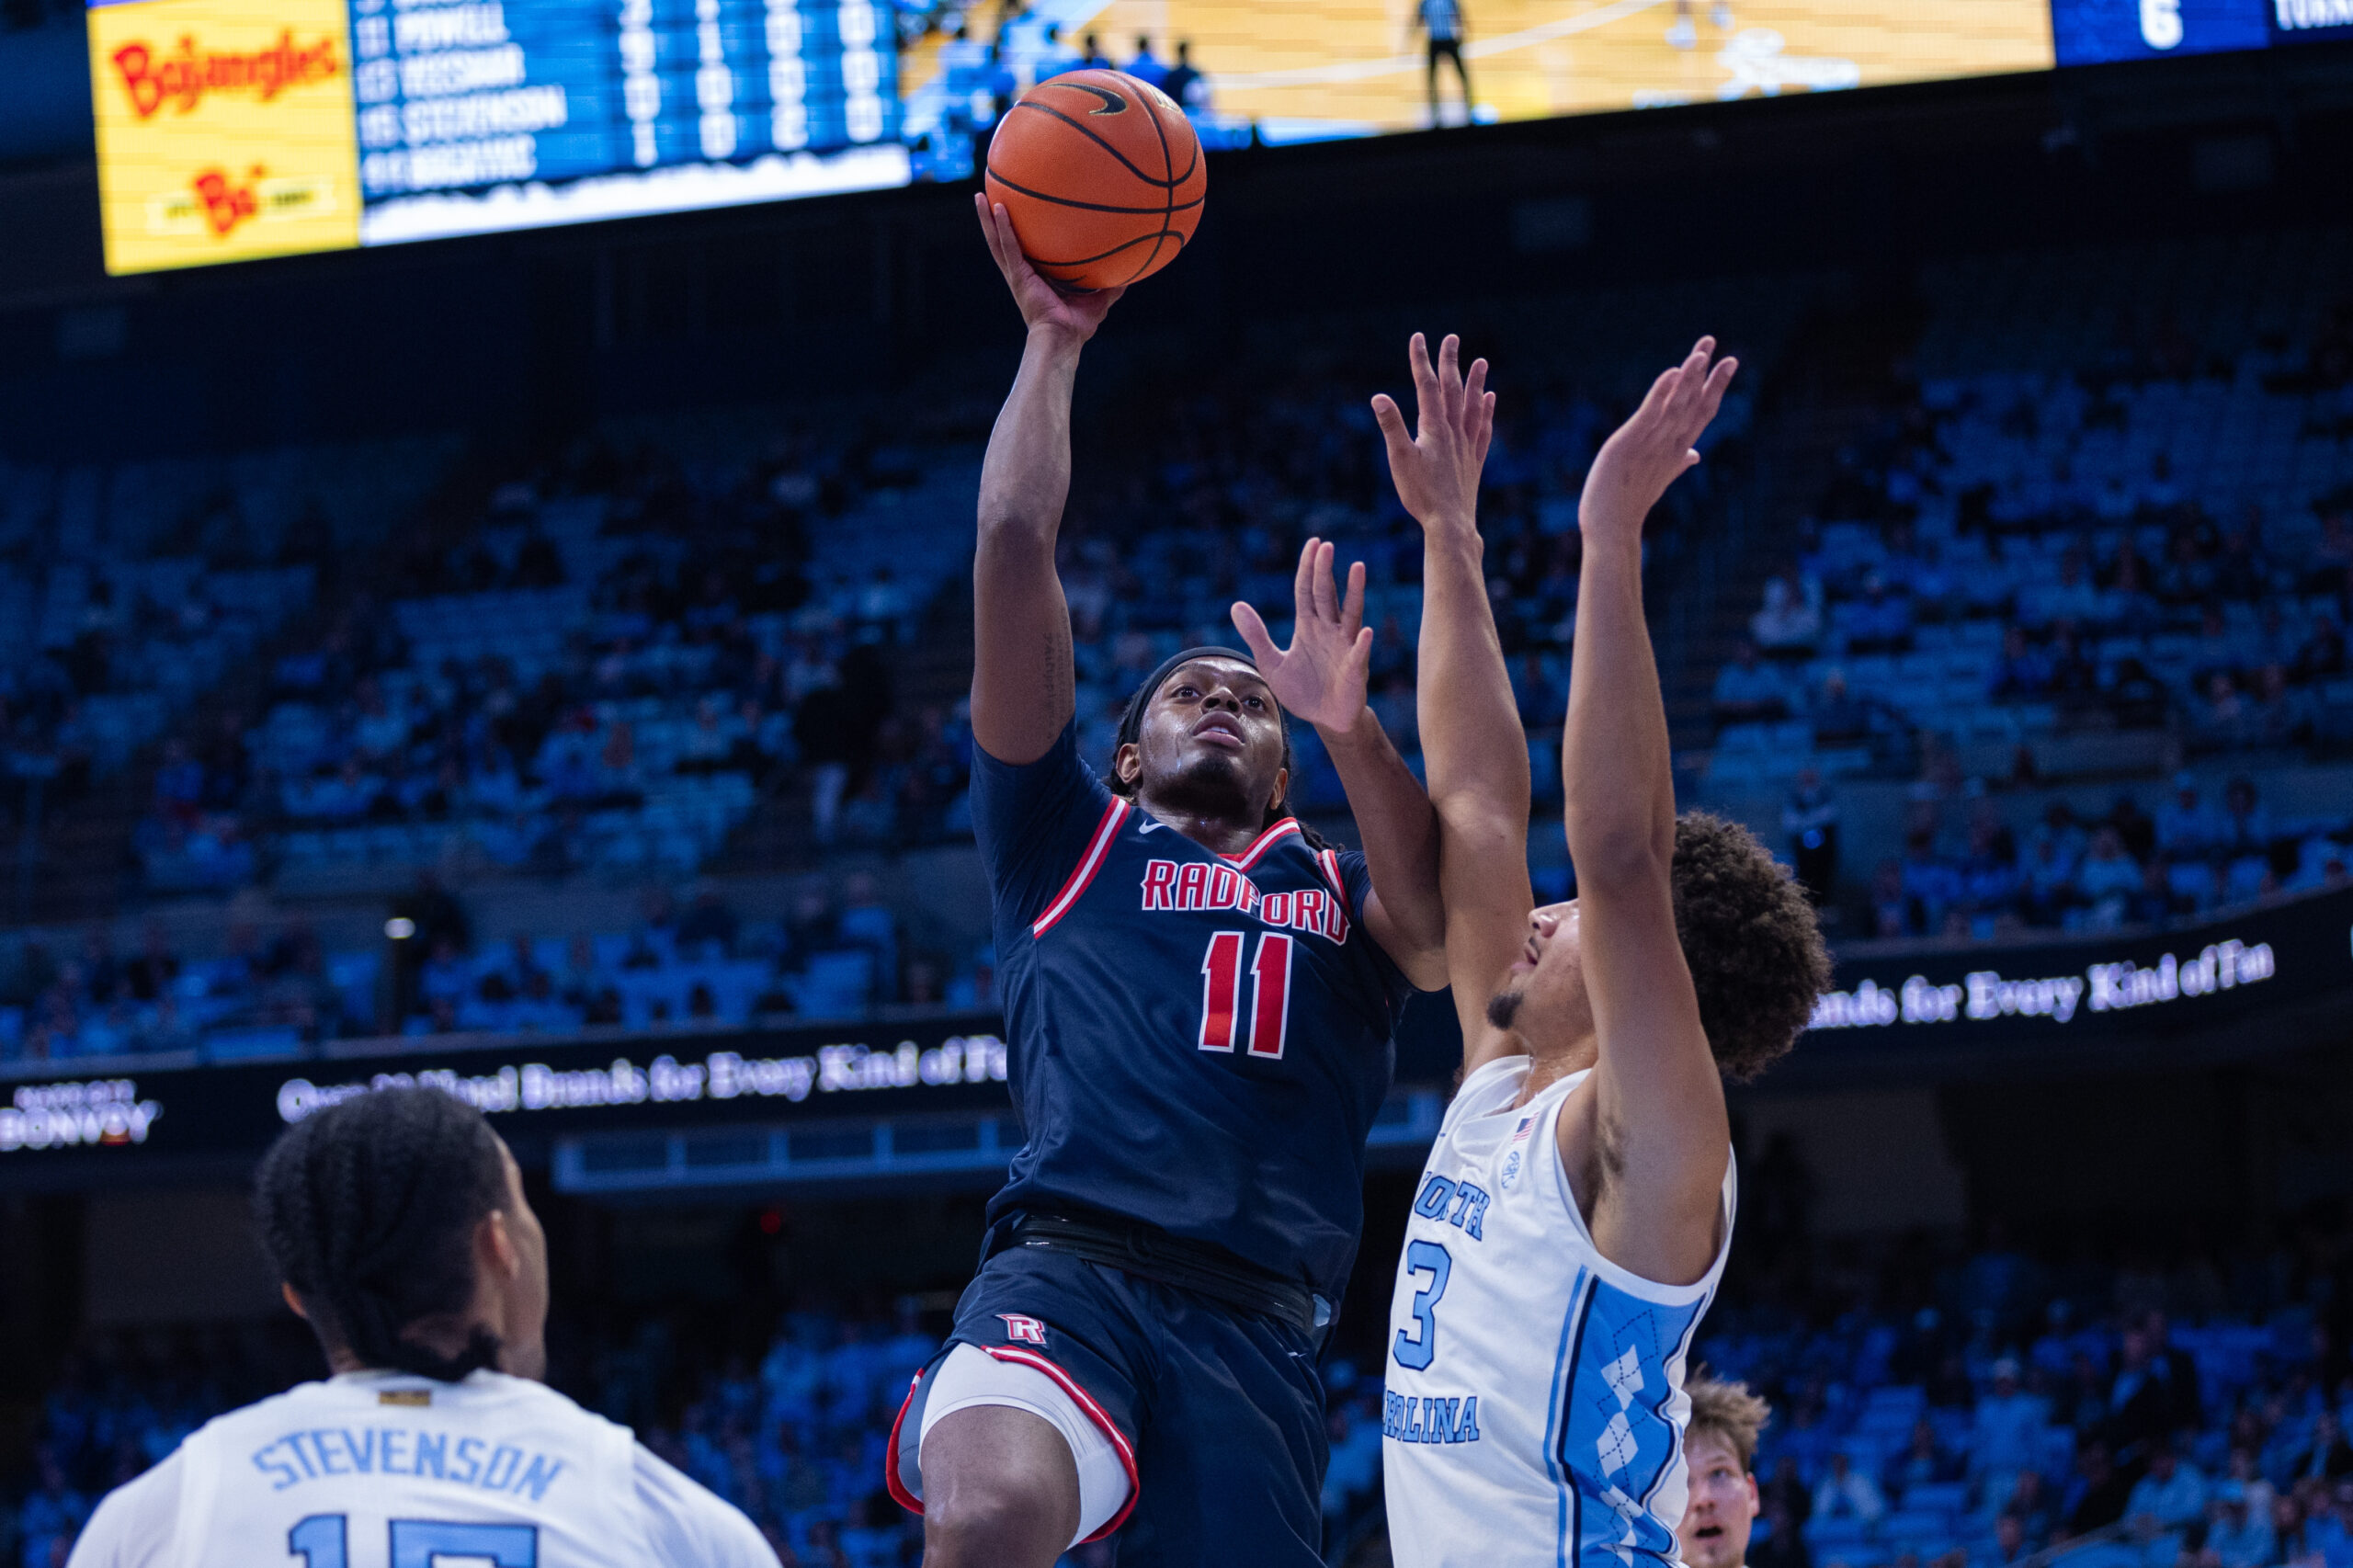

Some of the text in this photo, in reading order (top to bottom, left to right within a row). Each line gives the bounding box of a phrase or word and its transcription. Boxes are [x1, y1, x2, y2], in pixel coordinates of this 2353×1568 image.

[113, 29, 338, 119] Bojangles
[1142, 858, 1350, 946] RADFORD
[1198, 931, 1293, 1060] 11
[995, 1313, 1047, 1344] R
[1393, 1239, 1451, 1371] 3
[252, 1426, 563, 1502] STEVENSON
